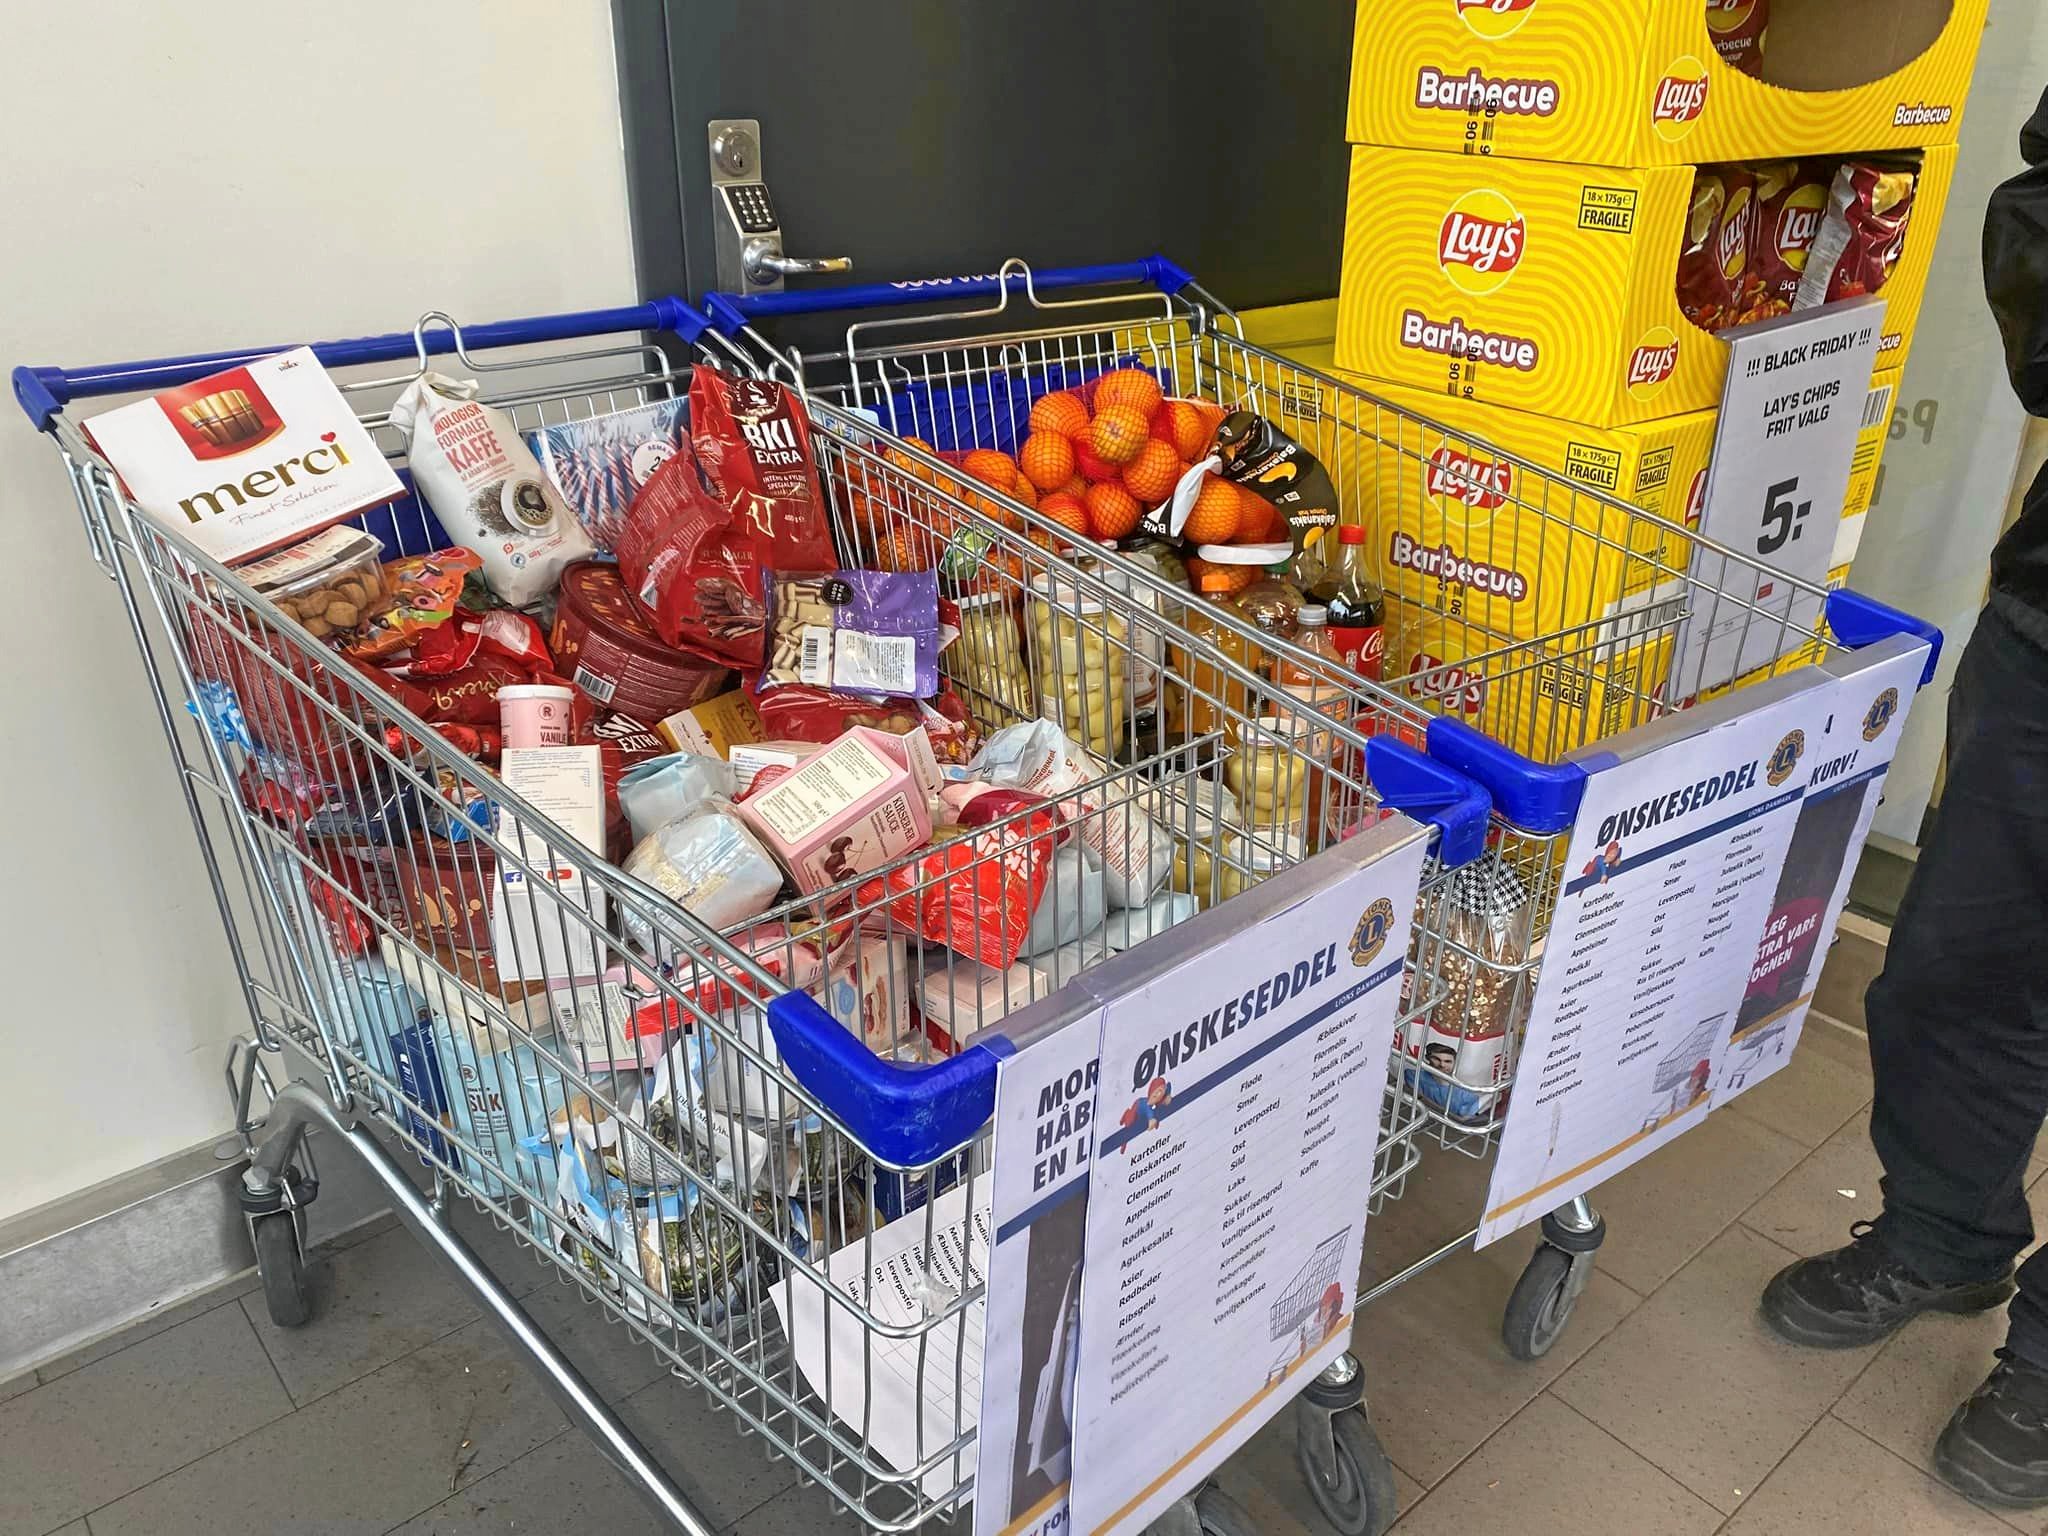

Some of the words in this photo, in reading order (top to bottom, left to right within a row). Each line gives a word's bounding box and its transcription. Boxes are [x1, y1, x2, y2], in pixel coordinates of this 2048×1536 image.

[1418, 70, 1556, 112] Barbecue
[1655, 77, 1706, 122] Lay's
[1894, 103, 1951, 126] Barbecue
[1587, 191, 1596, 201] 18
[1583, 209, 1629, 228] FRAGILE
[1442, 213, 1521, 273] Lay's
[1403, 315, 1535, 366] Barbecue
[1747, 359, 1761, 378] !!!
[1764, 347, 1808, 373] BLACK
[1810, 332, 1857, 360] FRIDAY
[1857, 328, 1872, 346] !!!
[1630, 344, 1677, 385] Lay's
[1763, 391, 1800, 418] LAY'S
[1802, 380, 1841, 405] CHIPS
[436, 416, 490, 451] FORMALET
[742, 418, 797, 451] BKI
[1766, 416, 1795, 439] FRIT
[1798, 404, 1830, 429] VALG
[445, 430, 503, 473] KAFFE
[754, 450, 803, 466] EXTRA
[178, 431, 351, 525] merci
[1431, 450, 1508, 507] Lay's
[1569, 463, 1613, 485] FRAGILE
[1638, 467, 1667, 488] FRAGILE
[282, 482, 340, 507] Selection
[1393, 536, 1523, 597] Barbecue
[616, 733, 663, 753] EXTRA
[1809, 750, 1859, 787] KURV!
[882, 803, 900, 834] SAUCE
[892, 796, 916, 843] KIRSEBÆR
[1595, 760, 1759, 849] ØNSKESEDDEL
[1583, 892, 1615, 909] Kartofler
[1658, 884, 1696, 907] Leverpostej
[1579, 900, 1625, 923] Glaskartofler
[1654, 912, 1666, 923] Ost
[1575, 918, 1618, 941] Clementiner
[1650, 925, 1664, 936] Sild
[1787, 913, 1818, 944] VARE
[1570, 937, 1608, 958] Appelsiner
[1645, 944, 1661, 955] Laks
[1335, 989, 1355, 1008] LIONS
[1355, 970, 1389, 996] DANMARK
[1562, 971, 1603, 994] Agurkesalat
[1132, 942, 1337, 1093] ØNSKESEDDEL
[1316, 1013, 1357, 1043] Æbleskiver
[1313, 1037, 1347, 1062] Flormelis
[1240, 1073, 1263, 1092] Fløde
[1233, 1097, 1280, 1136] Leverpostej
[1236, 1092, 1259, 1112] Smør
[1306, 1093, 1339, 1120] Marcipan
[1035, 1100, 1091, 1156] HÅB
[1303, 1114, 1330, 1139] Nougat
[1128, 1141, 1187, 1184] Glaskartofler
[1130, 1135, 1171, 1166] Kartofler
[1230, 1154, 1246, 1171] Sild
[1232, 1140, 1246, 1154] Ost
[1033, 1147, 1067, 1192] EN
[1227, 1175, 1246, 1192] Laks
[1300, 1159, 1319, 1177] Kaffe
[1126, 1163, 1182, 1205] Clementiner
[1124, 1189, 1173, 1226] Appelsiner
[1223, 1190, 1251, 1215] Sukker
[1121, 1219, 1153, 1248] Rødkål
[1221, 1206, 1274, 1249] Vaniljesukker
[1222, 1217, 1235, 1231] Ris
[1236, 1207, 1245, 1220] til
[899, 1252, 913, 1277] Smør
[936, 1233, 961, 1278] Æbleskiver
[1120, 1227, 1174, 1271] Agurkesalat
[874, 1266, 885, 1284] Ost
[929, 1246, 949, 1285] bleskiver
[1120, 1268, 1144, 1291] Asier
[887, 1259, 915, 1310] Leverpostej
[1119, 1272, 1162, 1308] Rødbeder
[1215, 1271, 1256, 1306] Brunkager
[1213, 1282, 1266, 1325] Vaniljekranse
[1115, 1323, 1145, 1348] Ænder
